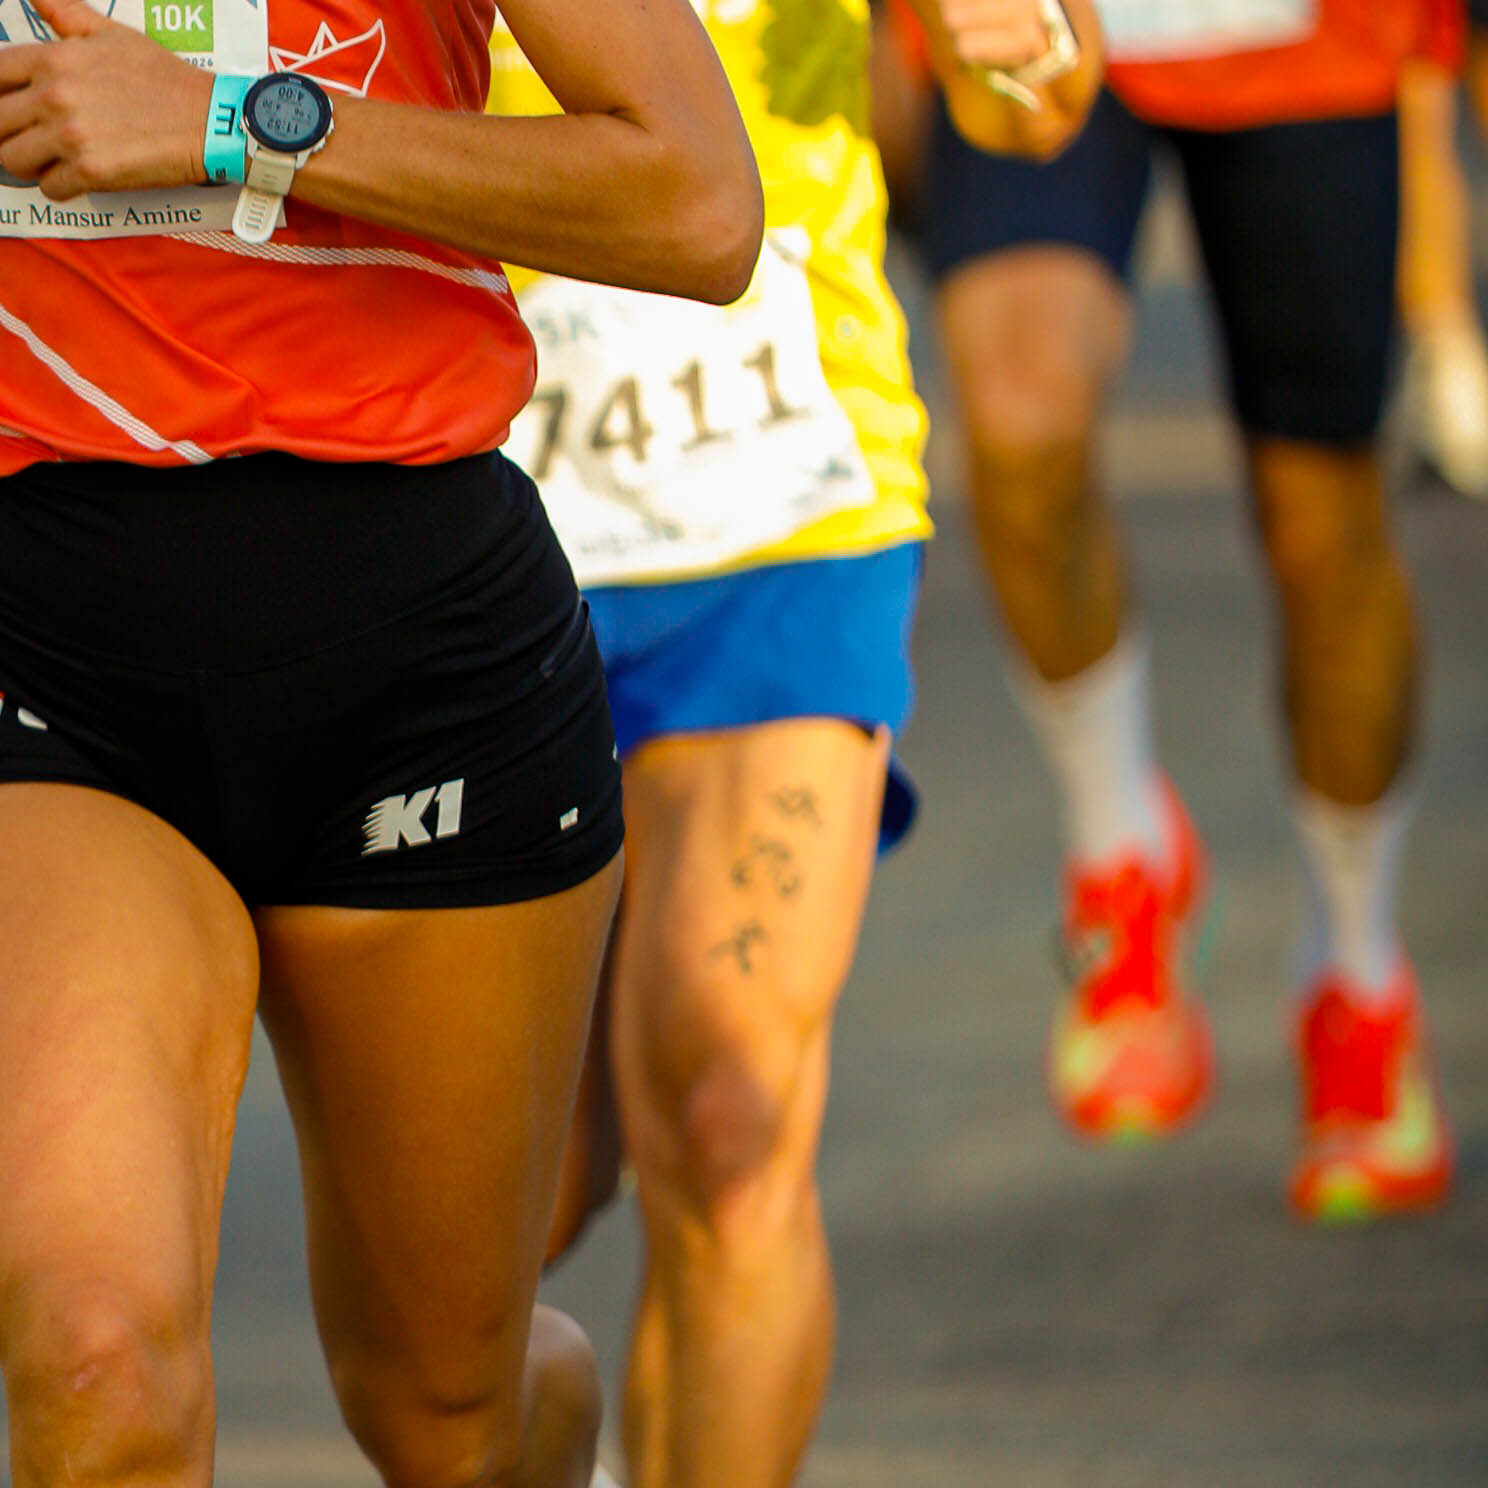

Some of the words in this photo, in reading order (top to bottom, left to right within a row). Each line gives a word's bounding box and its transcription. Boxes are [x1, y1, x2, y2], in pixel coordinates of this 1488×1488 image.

[151, 4, 206, 32] 10K
[29, 203, 115, 227] Mansur
[123, 204, 202, 226] Amine
[530, 339, 812, 481] 7411
[361, 778, 465, 857] K1
